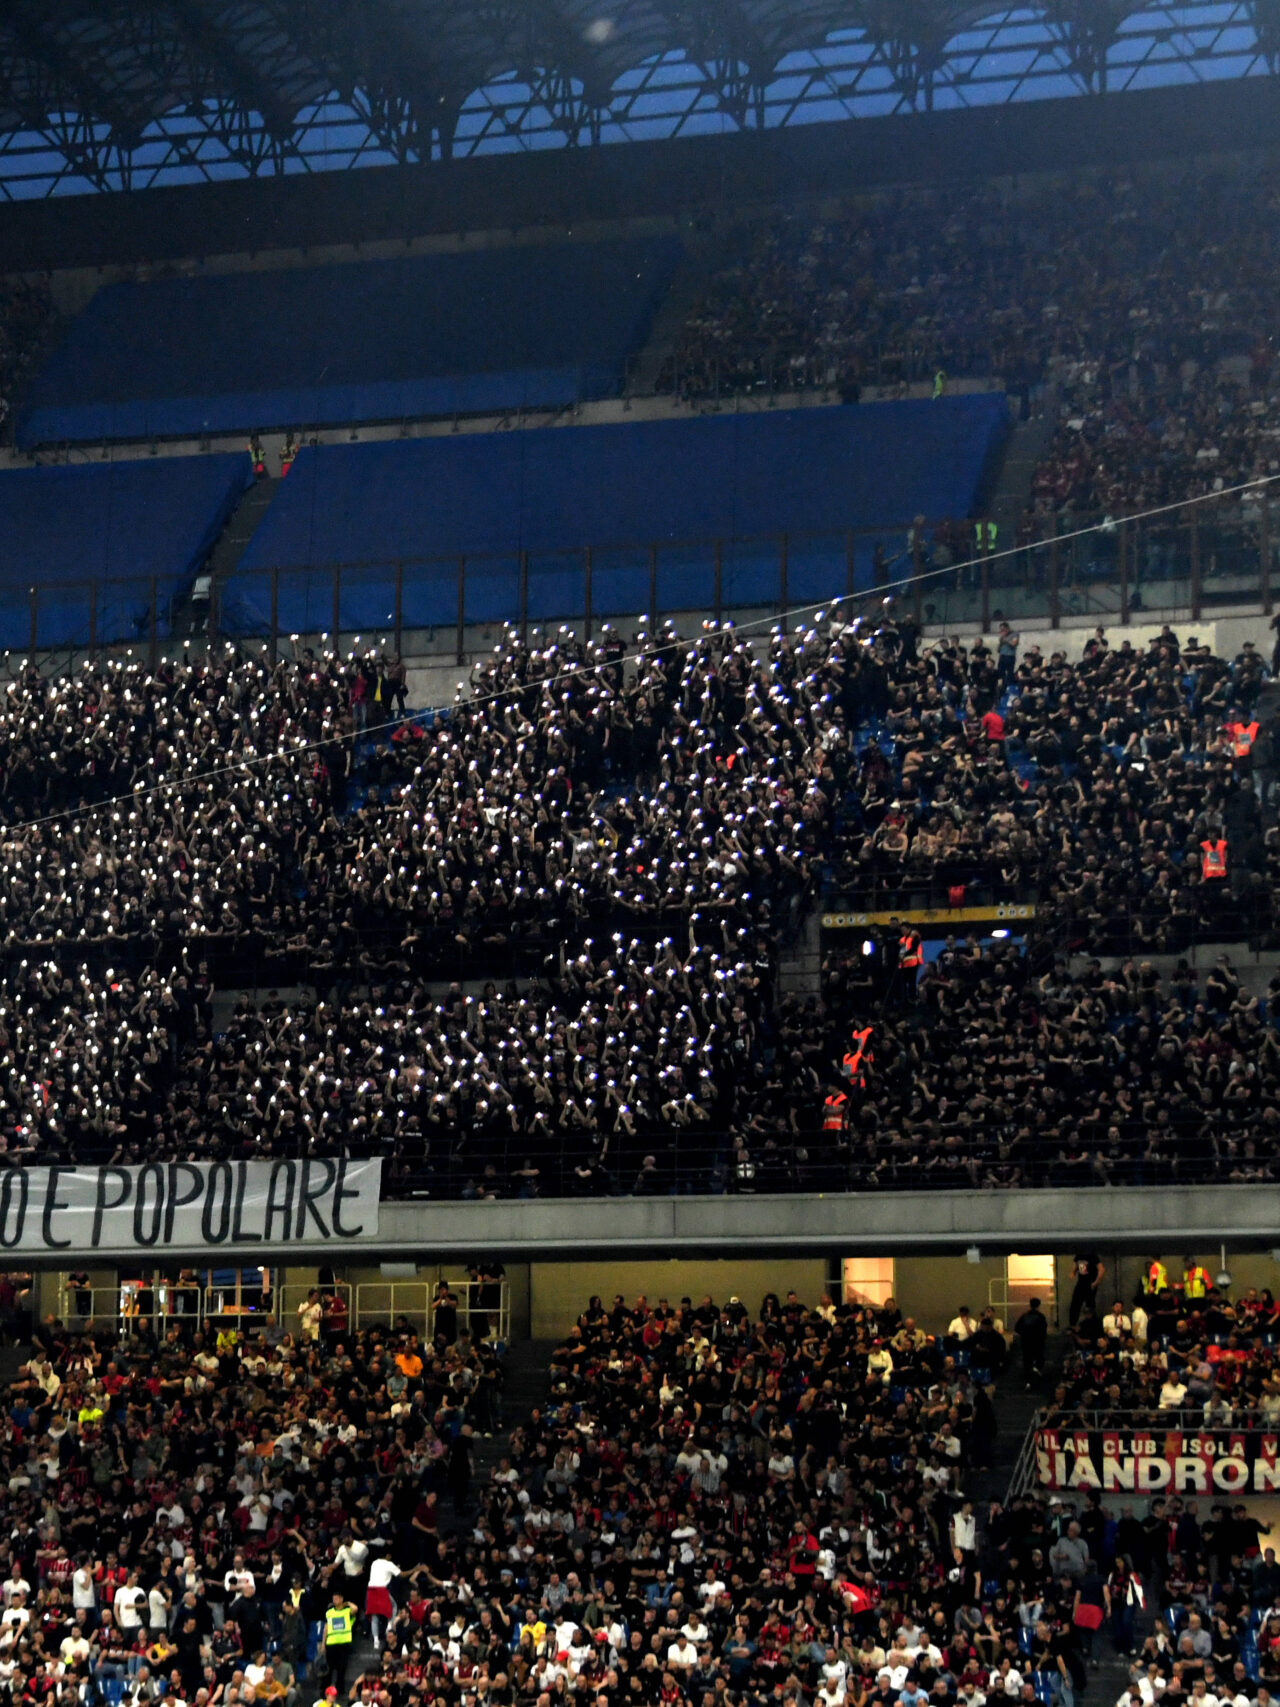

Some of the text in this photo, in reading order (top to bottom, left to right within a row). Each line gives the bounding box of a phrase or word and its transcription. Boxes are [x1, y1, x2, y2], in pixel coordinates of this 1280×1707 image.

[42, 1166, 77, 1248] E
[91, 1159, 363, 1247] POPOLARE
[1103, 1439, 1157, 1455] CLUB
[1182, 1438, 1245, 1457] ISOLA
